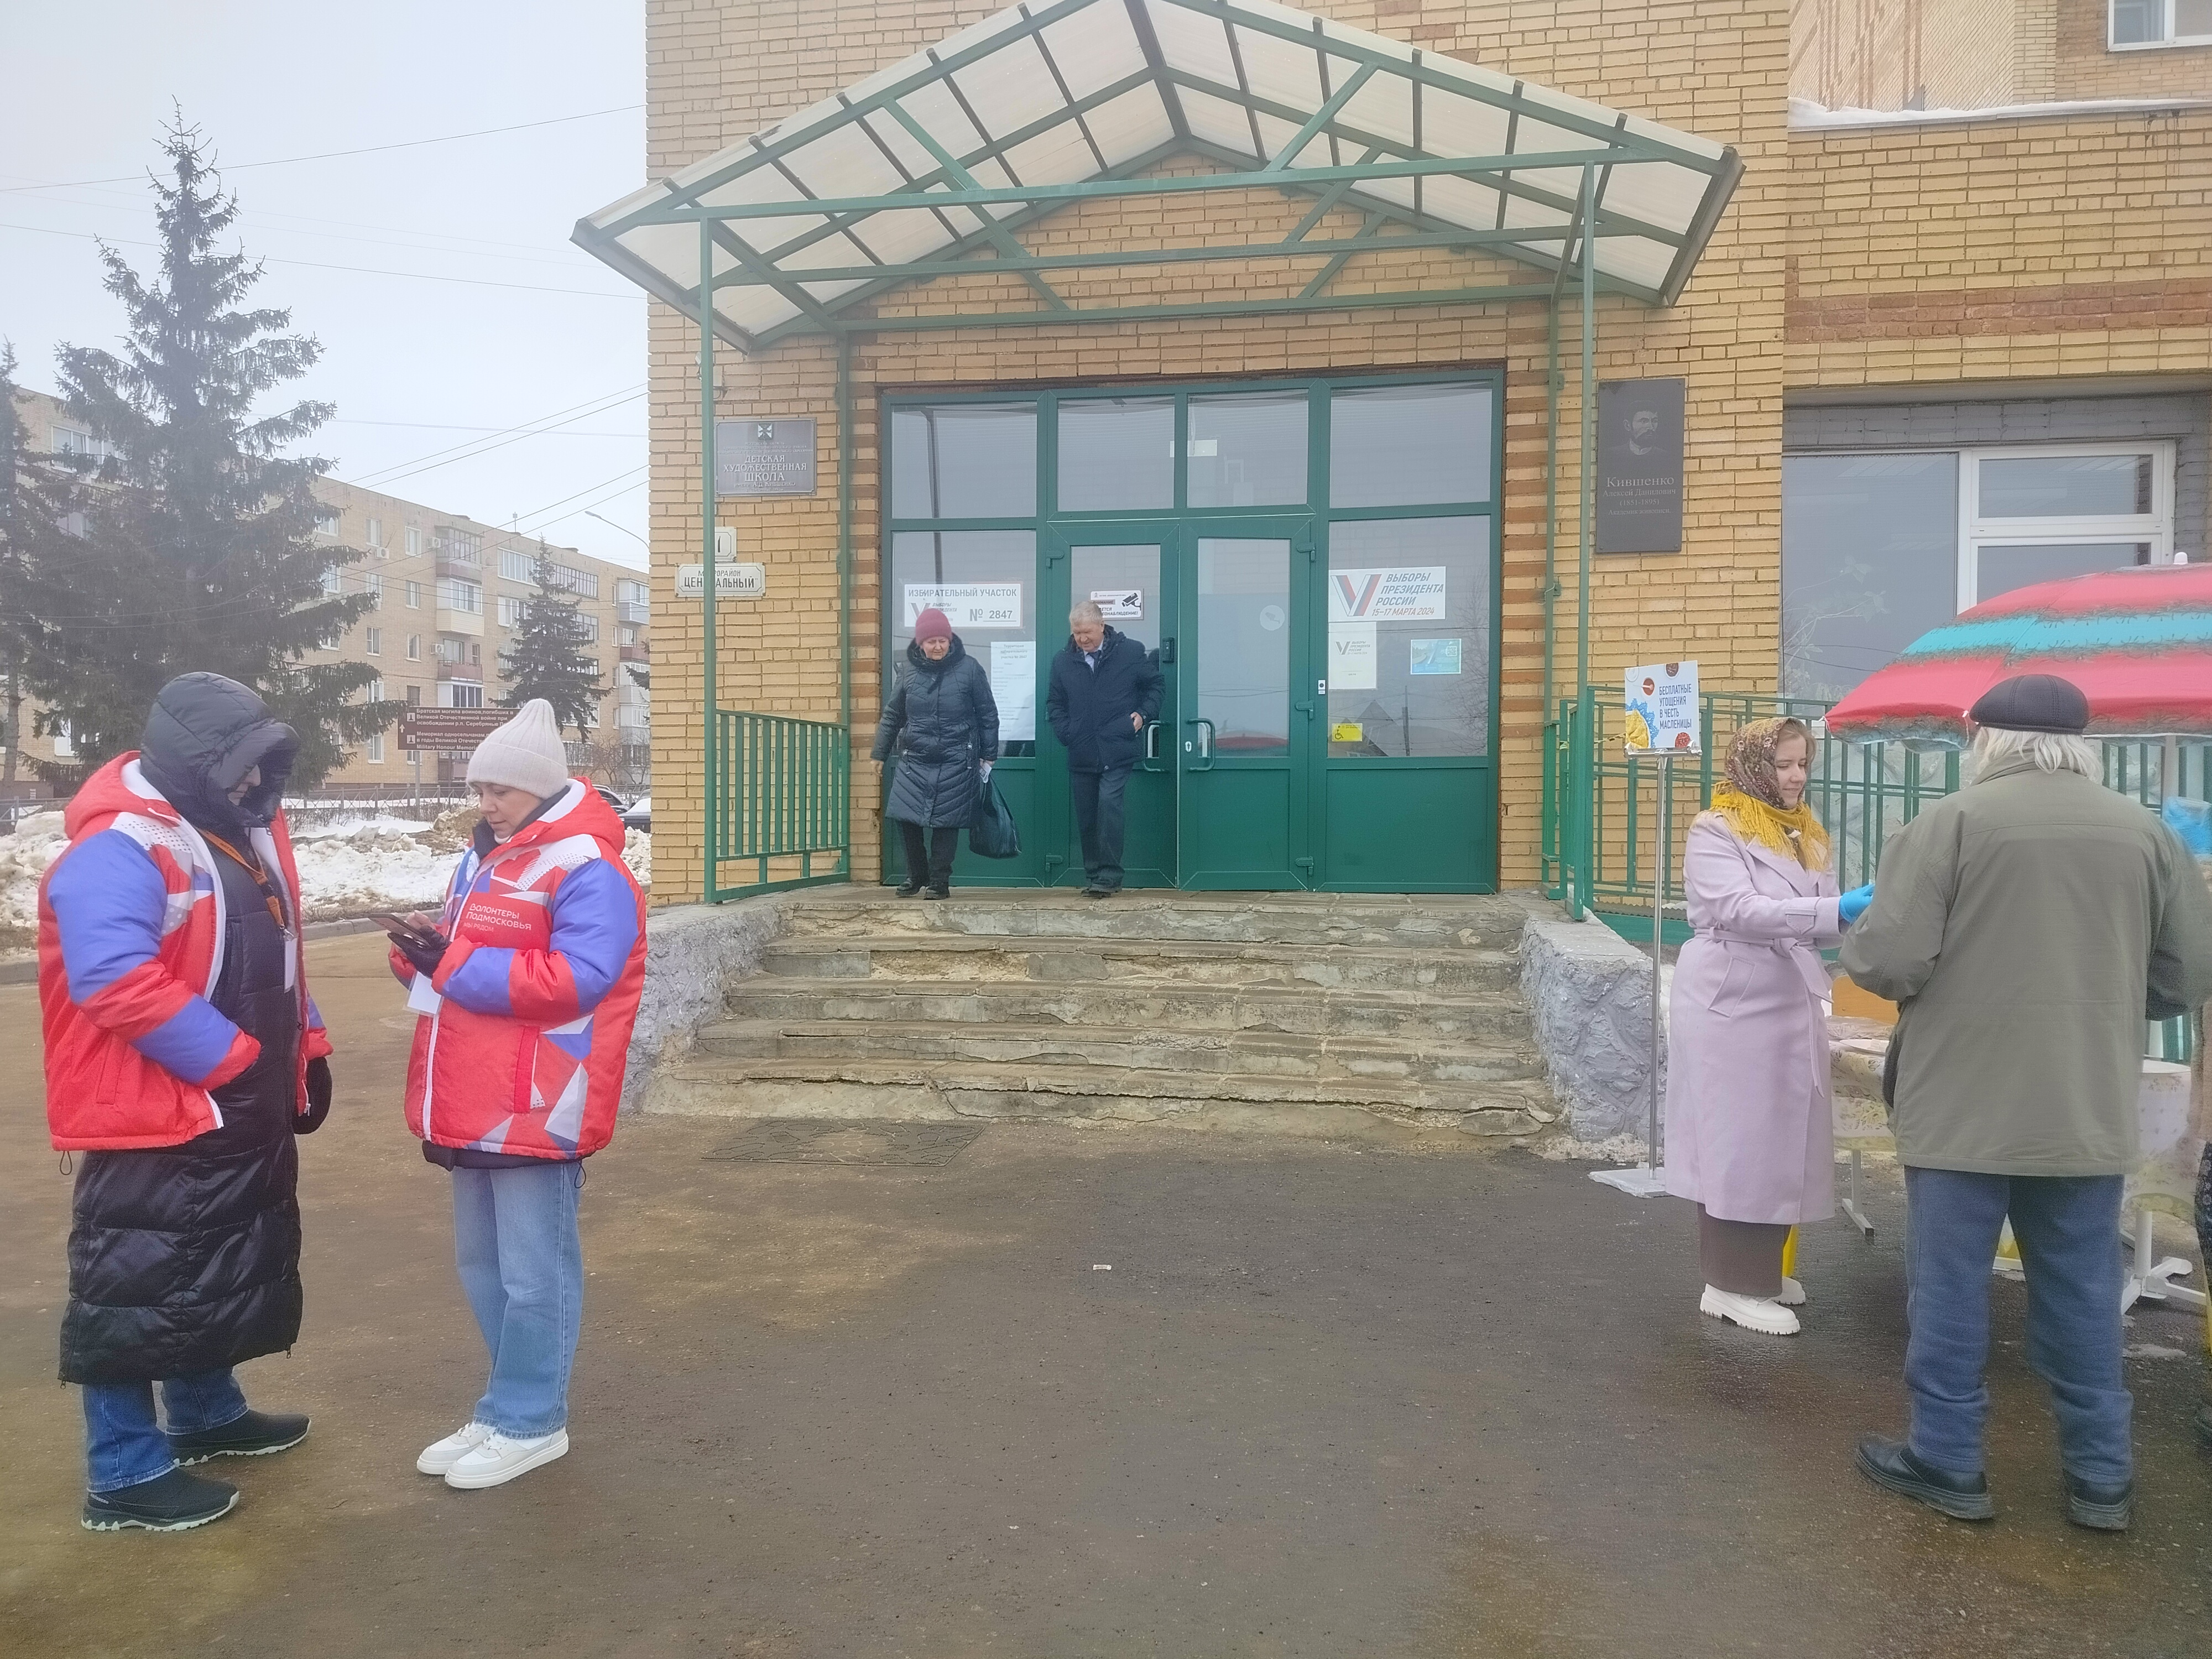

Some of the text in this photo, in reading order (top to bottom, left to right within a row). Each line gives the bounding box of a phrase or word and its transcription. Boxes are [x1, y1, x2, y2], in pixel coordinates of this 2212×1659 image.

[745, 455, 785, 463] ДЕТСКАЯ
[724, 463, 807, 472] ХУДОЖЕСТВЕННАЯ
[745, 473, 785, 482] ШКОЛА
[1606, 477, 1674, 487] Кившенко
[698, 568, 741, 577] МОРАЙОН
[1386, 572, 1431, 582] ВЫБОРЫ
[909, 588, 978, 597] ИЗБИРАТЕЛЬНЫЙ
[1380, 584, 1444, 594] ПРЕЗИДЕНТА
[1376, 597, 1417, 606] РОССИИ
[989, 610, 1013, 619] 2847
[1391, 608, 1416, 616] МАРТА
[1659, 684, 1692, 695] БЕСПЛАТНЫЕ
[1659, 695, 1687, 707] УГОЩЕНИЯ
[1660, 708, 1679, 718] В ЧЕСТЬ
[1660, 719, 1692, 729] МАСЛЕНИЦЫ
[469, 903, 520, 919] ВОЛОНТЕРЫ
[466, 911, 531, 930] ПОДМОСКОВЬЯ
[473, 923, 494, 932] РЯДОМ
